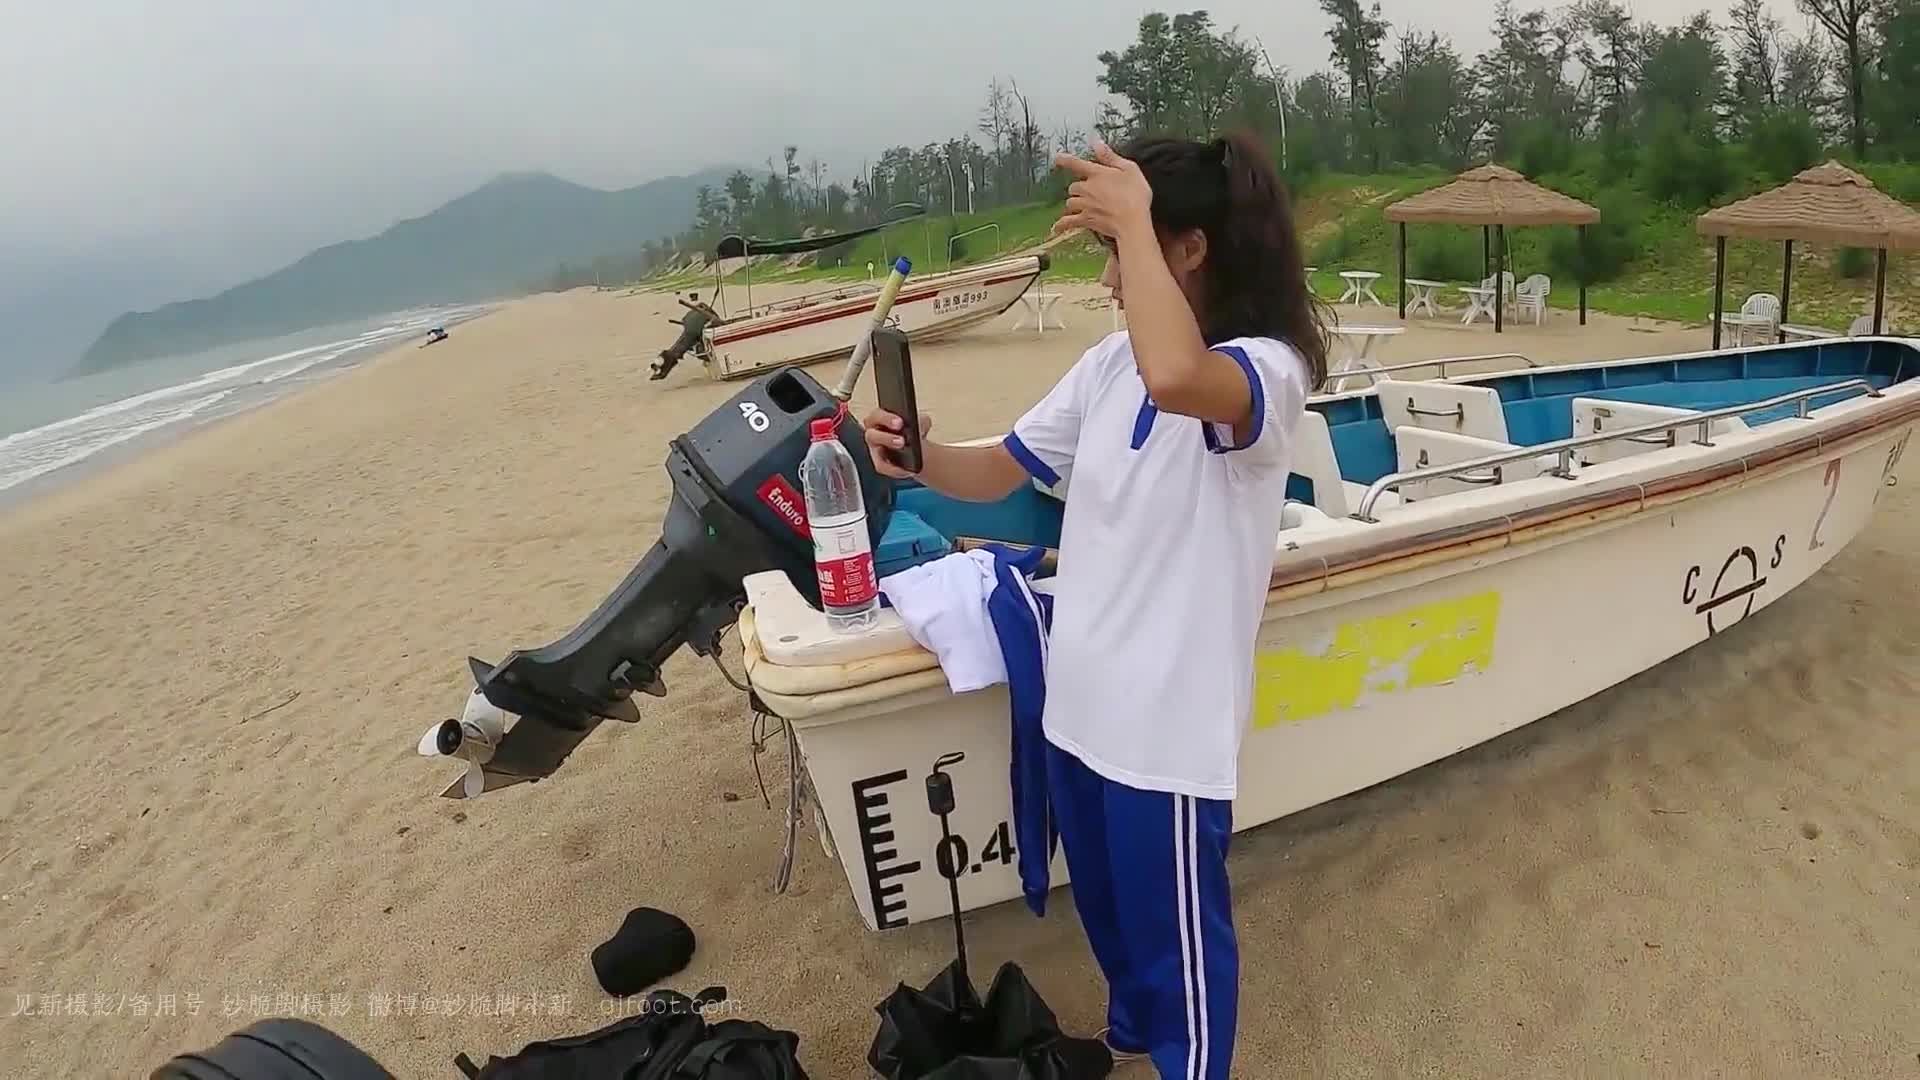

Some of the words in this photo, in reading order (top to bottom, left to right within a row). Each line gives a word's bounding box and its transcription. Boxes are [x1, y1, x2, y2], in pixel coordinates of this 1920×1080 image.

[738, 401, 770, 432] 40
[767, 486, 804, 526] Enduro
[1682, 565, 1700, 604] C
[1770, 534, 1786, 568] S
